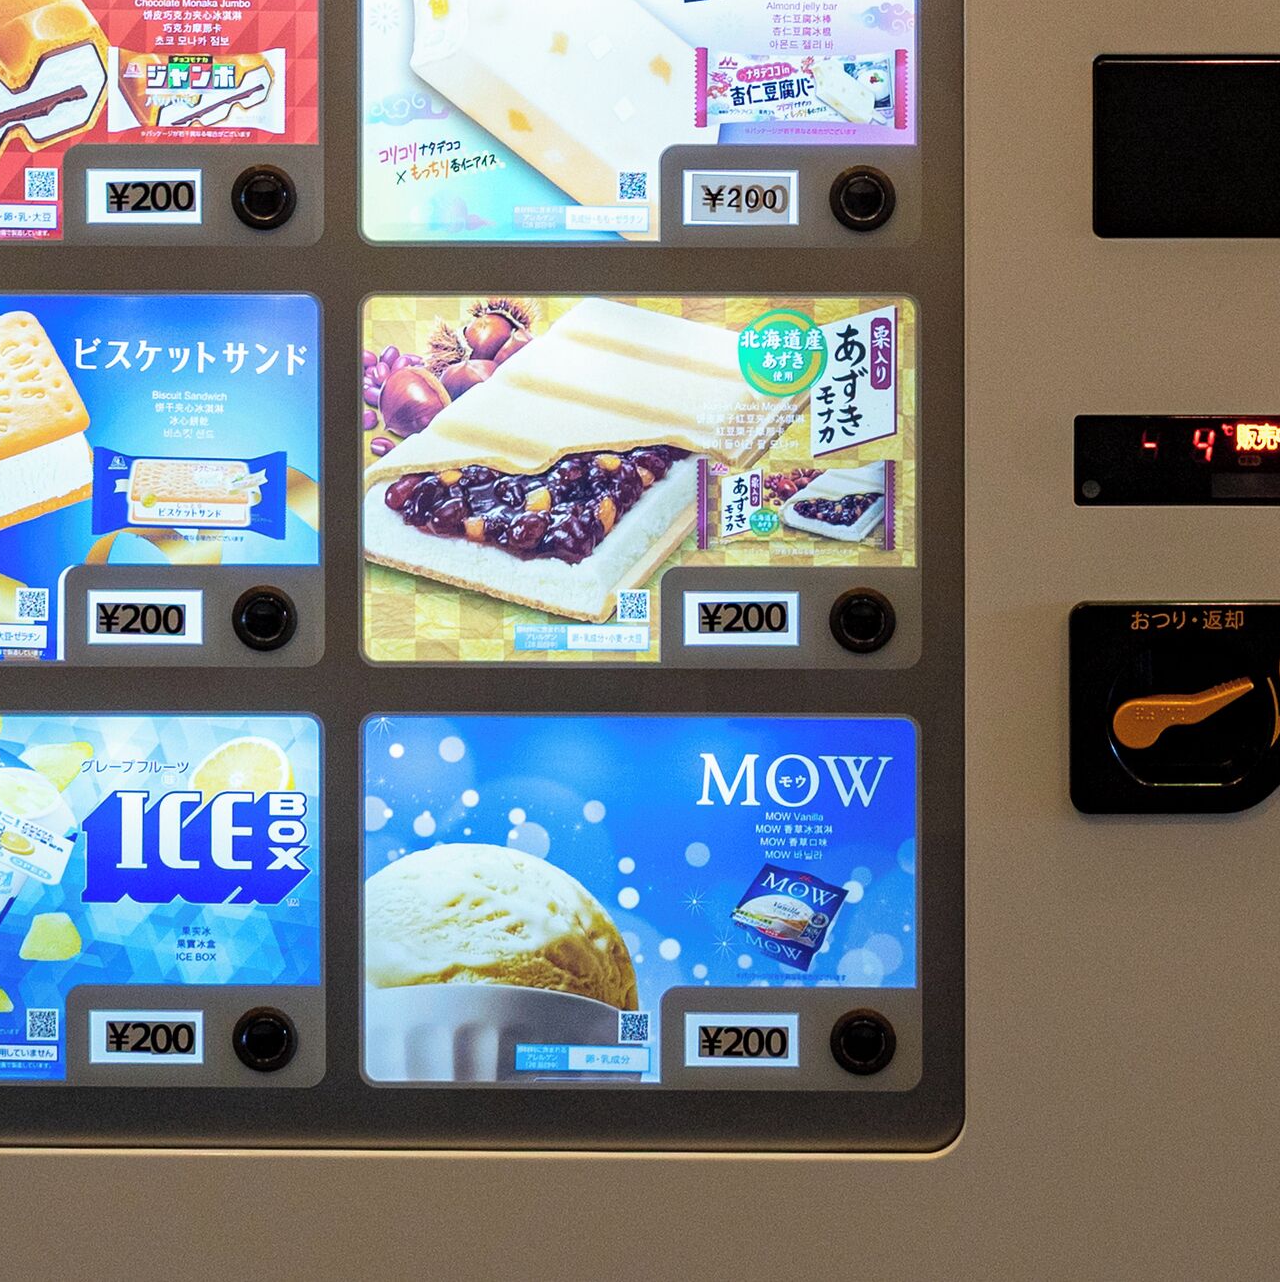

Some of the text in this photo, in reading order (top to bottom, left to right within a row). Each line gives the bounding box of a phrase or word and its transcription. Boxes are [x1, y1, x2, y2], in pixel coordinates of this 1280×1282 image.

[767, 2, 837, 13] Almond jelly bar
[825, 40, 833, 49] 바
[146, 66, 236, 88] ジャンボ
[730, 78, 814, 106] 杏仁豆腐バー
[379, 140, 460, 164] コリコリナタデココ
[411, 154, 497, 180] もっちり杏仁アイス
[109, 182, 194, 211] ¥200
[703, 188, 777, 209] ¥200
[741, 329, 824, 350] 北海道産
[75, 338, 307, 375] ビスケットサンド
[763, 353, 804, 368] あずき
[872, 326, 890, 383] 栗入り
[773, 372, 793, 382] 使用
[832, 324, 868, 436] あずき
[152, 391, 227, 401] Biscuit Sandwich
[817, 385, 835, 444] モナカ
[1192, 429, 1216, 462] 4
[159, 508, 221, 518] ビスケットサンド
[733, 477, 748, 528] あずき
[99, 604, 184, 634] ¥200
[702, 603, 787, 633] ¥200
[1130, 610, 1244, 630] おつり・返却
[82, 760, 189, 773] グレープフルーツ
[696, 753, 893, 808] MOW
[779, 775, 807, 788] モウ
[766, 812, 791, 821] MOW
[116, 791, 310, 870] ICE BOX
[756, 825, 781, 833] MOW
[760, 838, 786, 846] MOW
[765, 850, 791, 859] MOW
[761, 872, 838, 906] MOW
[176, 953, 216, 961] ICE BOX
[746, 932, 802, 960] MOW
[110, 1023, 194, 1052] ¥200
[702, 1027, 787, 1057] ¥200
